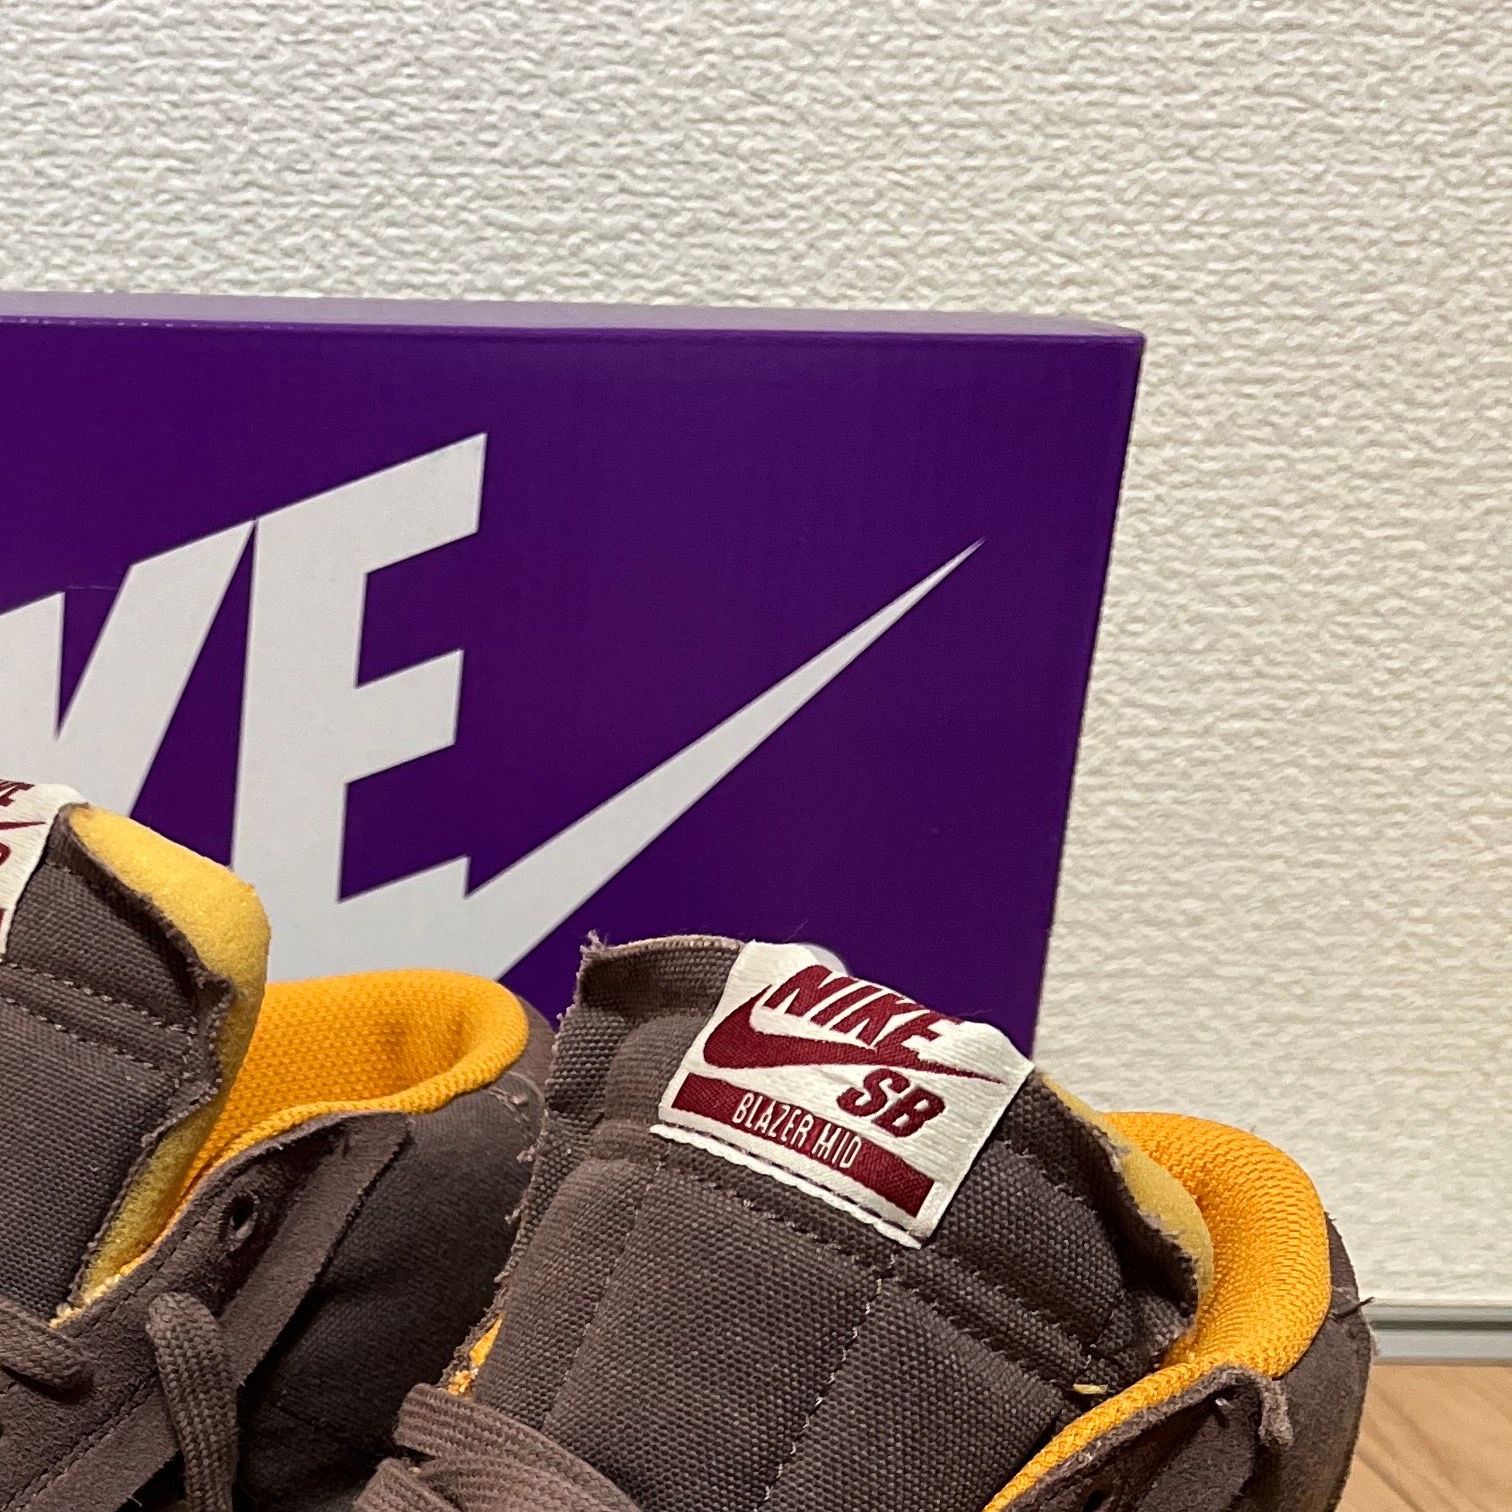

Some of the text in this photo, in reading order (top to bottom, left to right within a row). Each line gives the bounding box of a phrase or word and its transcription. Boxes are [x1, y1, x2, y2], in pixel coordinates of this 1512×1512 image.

[762, 964, 966, 1057] NIKE
[732, 1092, 863, 1169] BLAZER MID
[837, 1067, 946, 1138] SB
